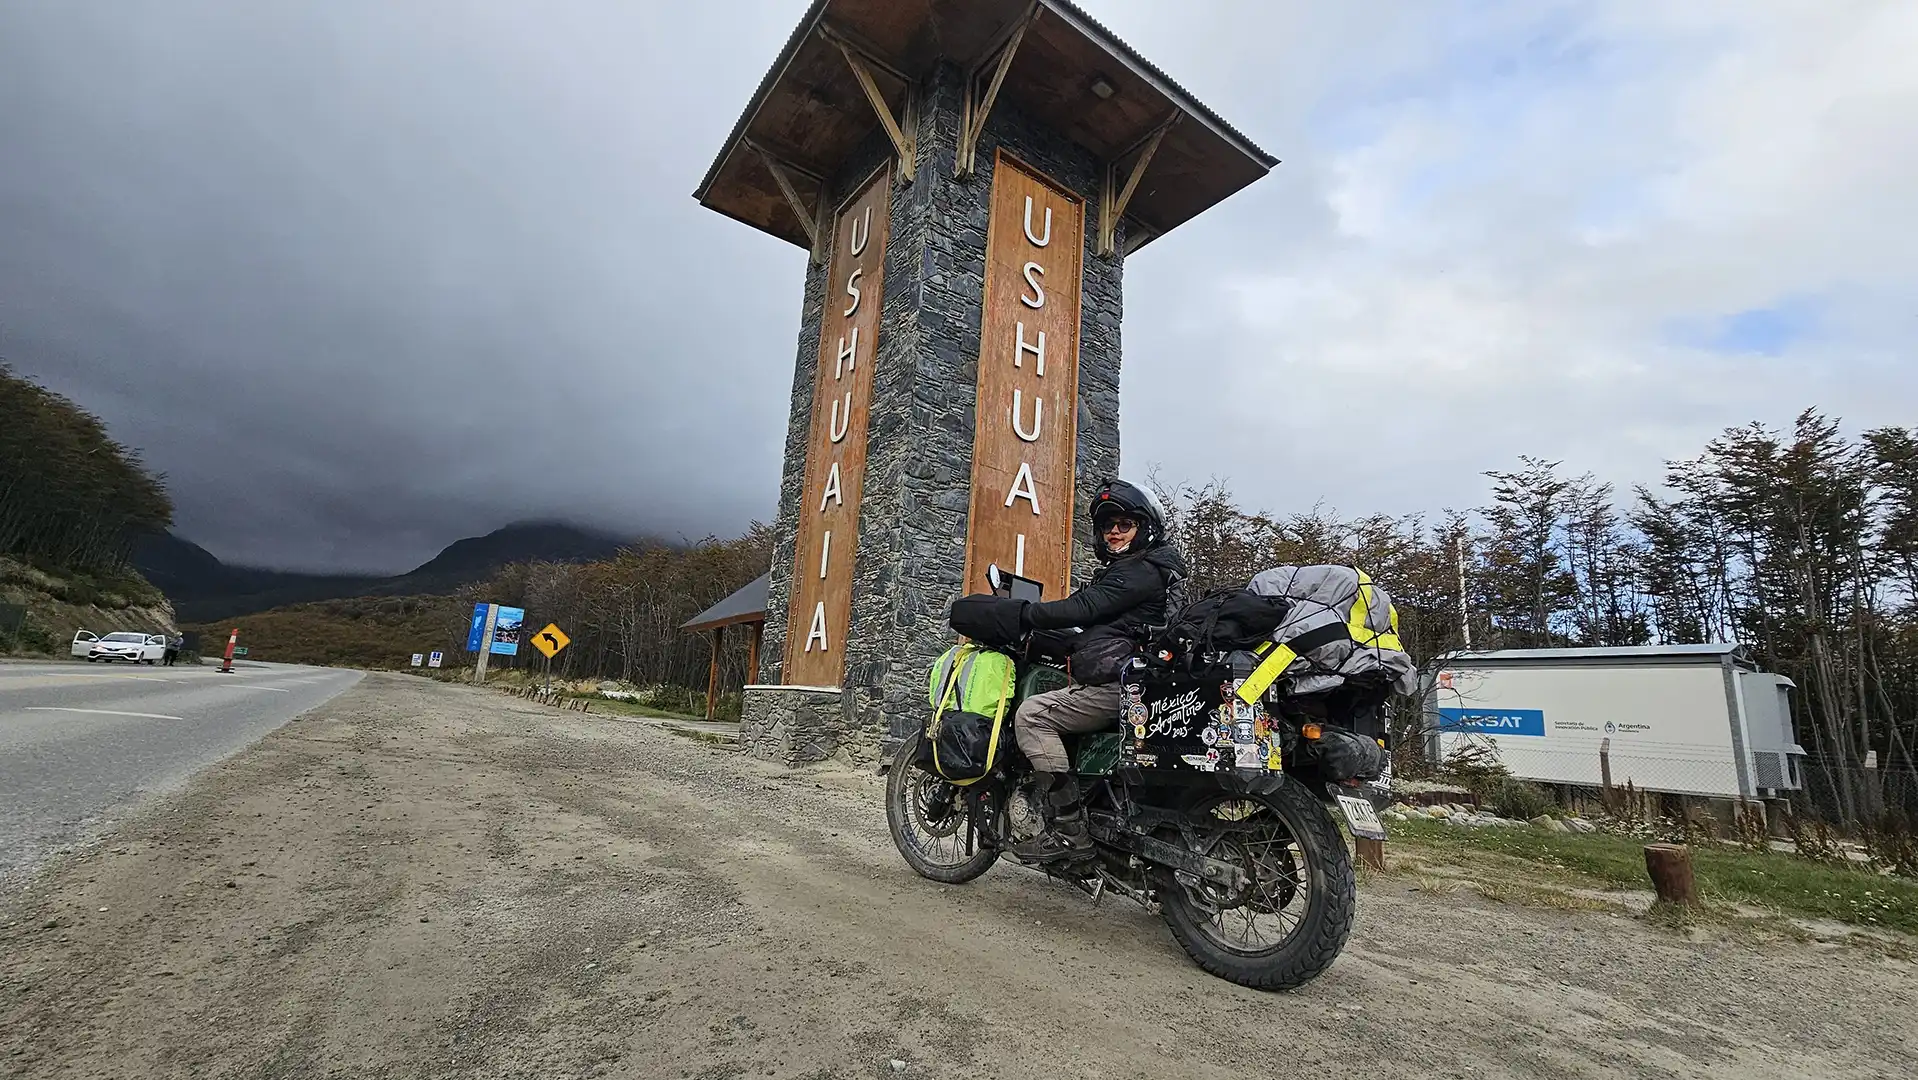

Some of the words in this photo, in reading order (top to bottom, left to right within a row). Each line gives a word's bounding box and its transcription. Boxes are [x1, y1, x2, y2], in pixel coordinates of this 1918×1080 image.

[805, 206, 871, 653] USHUAIA
[1004, 195, 1052, 579] USHUAI
[1459, 714, 1523, 729] ARSAT
[1618, 722, 1651, 731] Argentina
